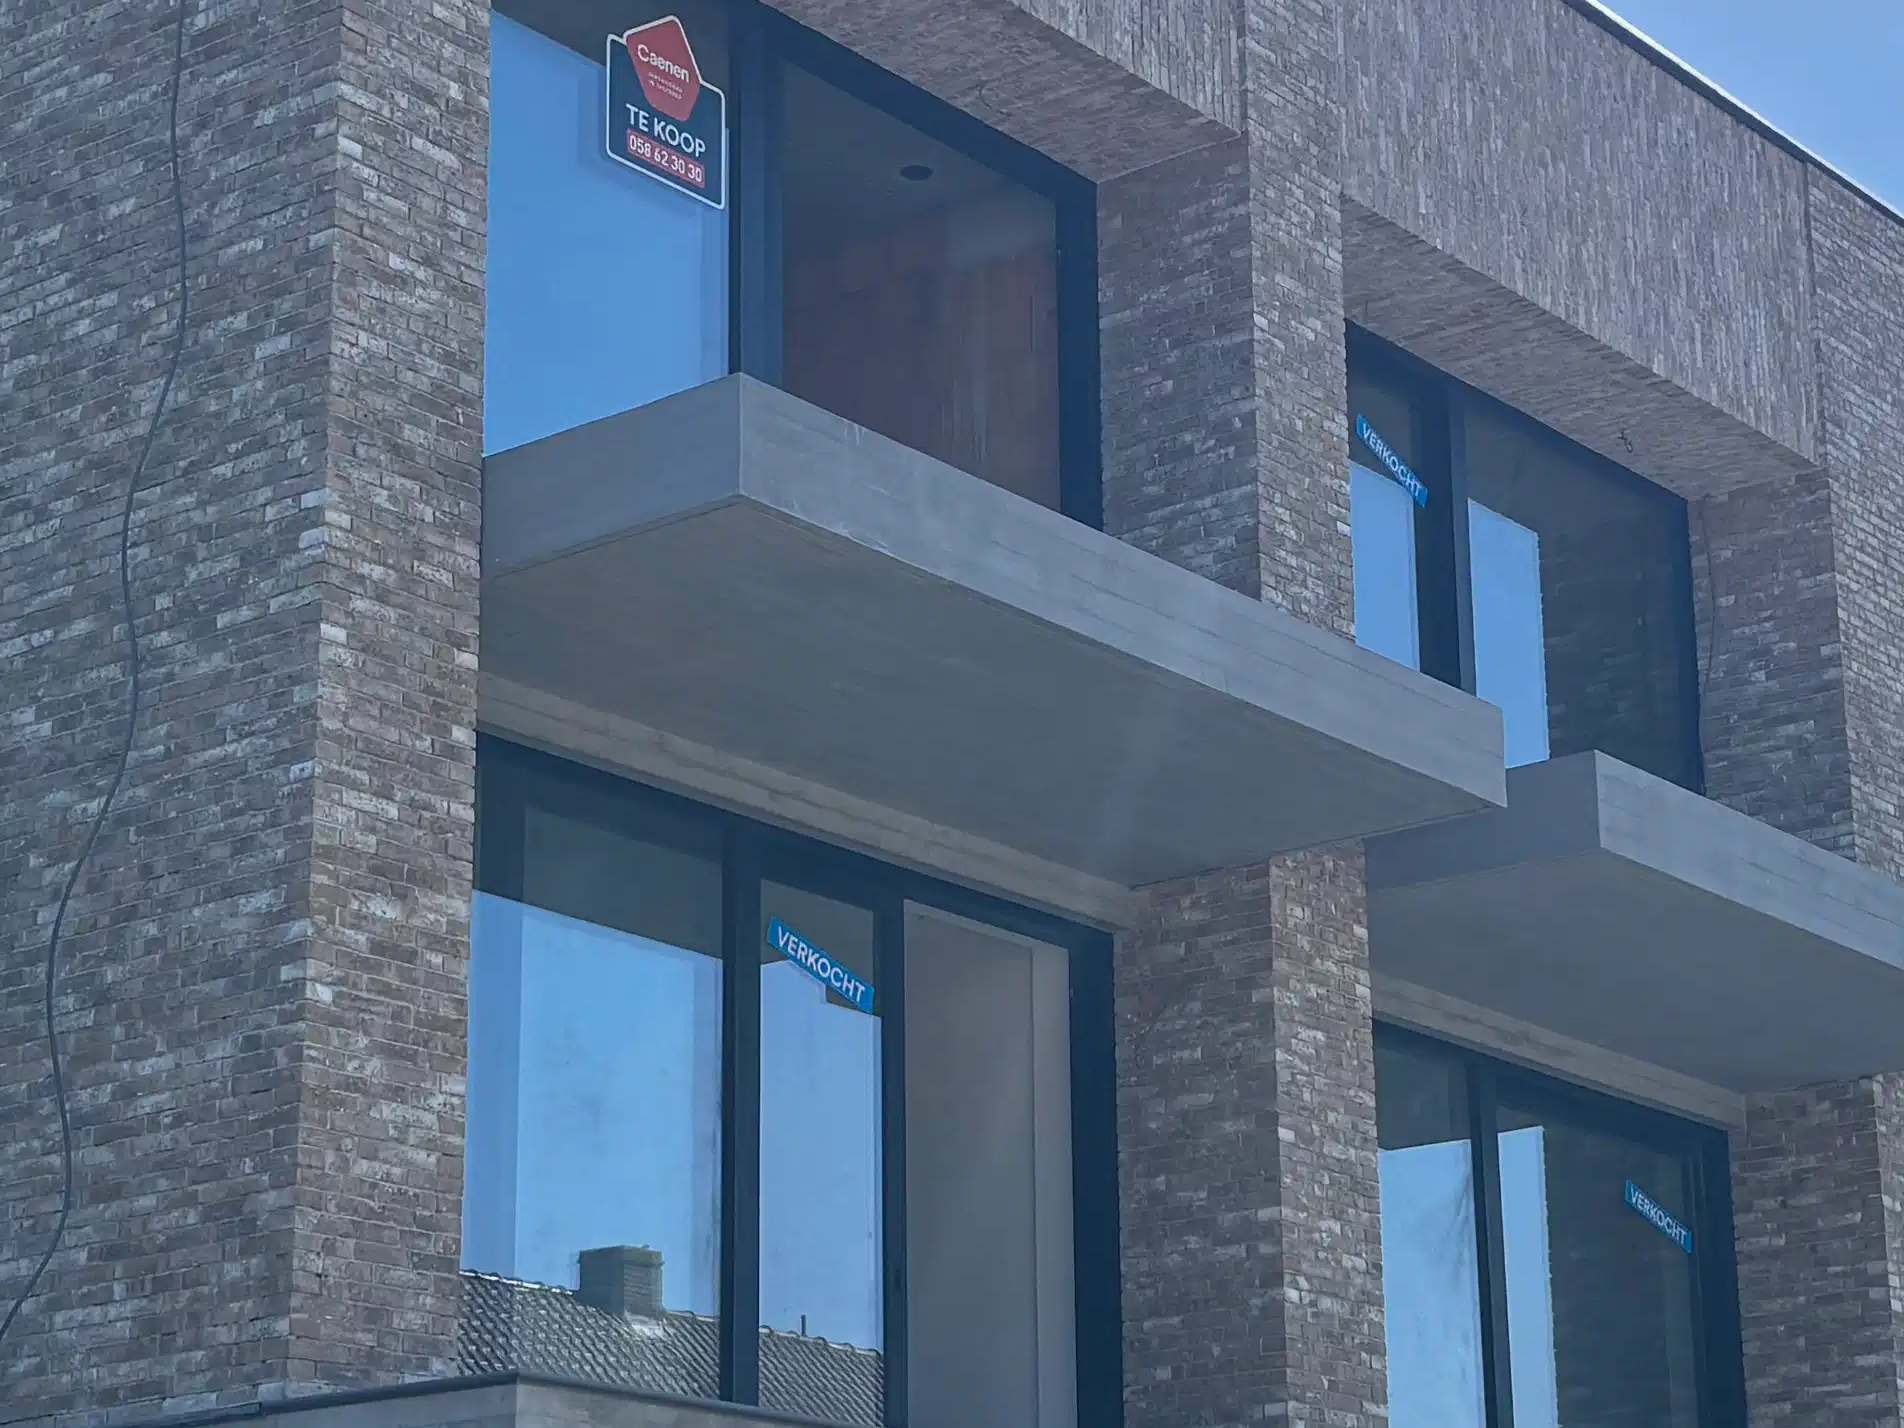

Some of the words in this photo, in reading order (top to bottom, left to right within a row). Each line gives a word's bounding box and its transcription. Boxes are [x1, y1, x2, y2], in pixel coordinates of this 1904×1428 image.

[637, 44, 690, 83] Caenen
[626, 103, 649, 132] TE
[654, 117, 706, 157] KOOP
[629, 134, 652, 158] 058
[654, 147, 669, 167] 62
[671, 155, 685, 175] 30
[688, 163, 702, 183] 30
[1362, 422, 1421, 497] VERKOCHT
[778, 925, 866, 1003] VERKOCHT
[1630, 1183, 1688, 1245] VERKOCHT
